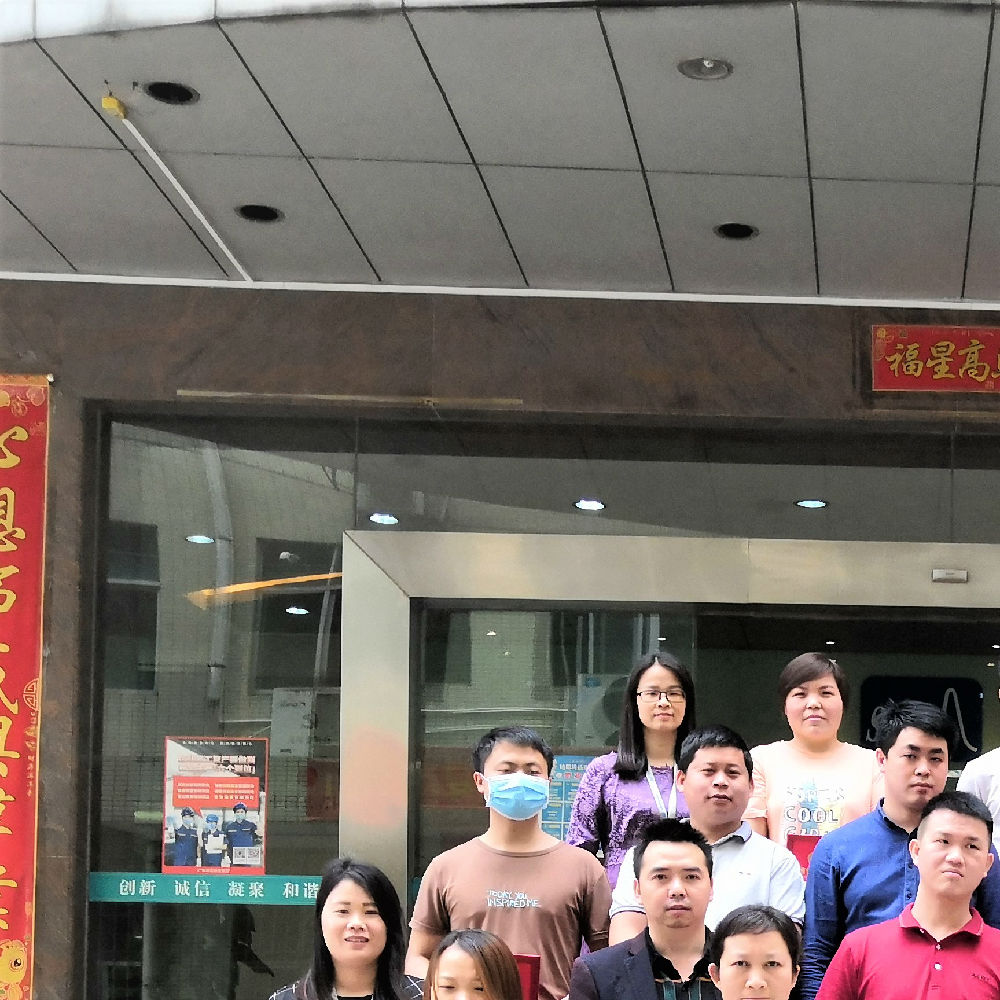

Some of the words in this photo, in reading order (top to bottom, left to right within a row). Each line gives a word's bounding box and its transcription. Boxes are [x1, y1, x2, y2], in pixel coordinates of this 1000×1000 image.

[784, 805, 838, 824] COOL
[119, 879, 157, 896] 创新
[174, 879, 210, 897] 诚信
[228, 881, 264, 898] 凝聚
[283, 881, 319, 899] 和谐
